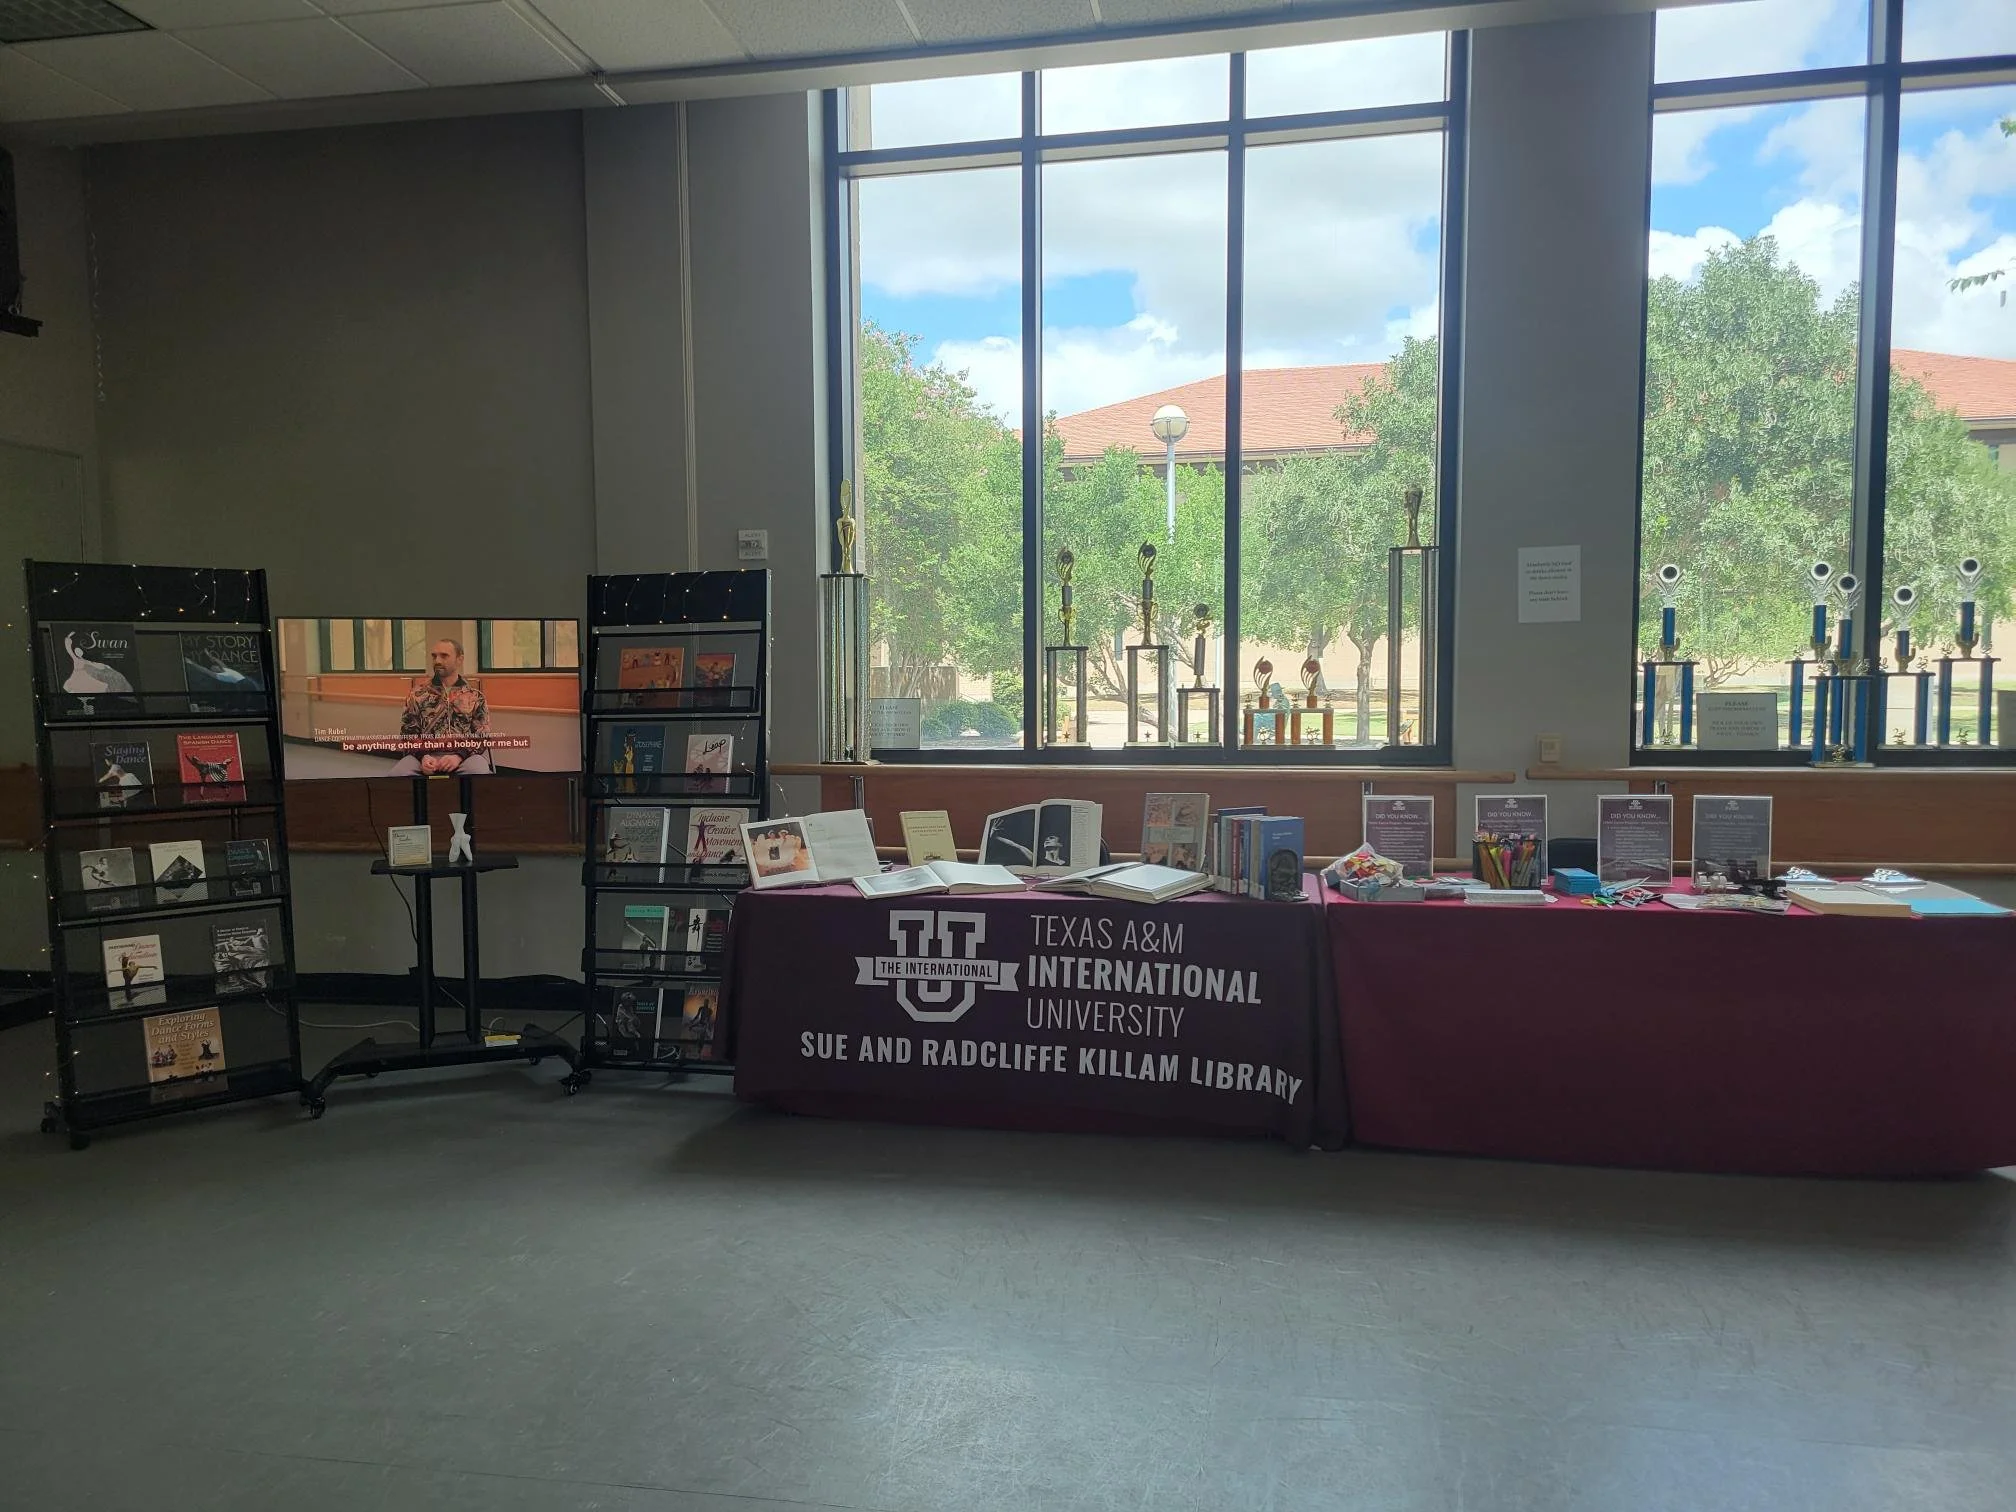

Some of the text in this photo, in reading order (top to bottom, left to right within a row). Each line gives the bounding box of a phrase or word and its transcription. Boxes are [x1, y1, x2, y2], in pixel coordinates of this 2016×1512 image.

[80, 631, 128, 650] Swan
[206, 635, 257, 649] STORY,
[209, 650, 259, 663] DANCE
[342, 742, 355, 751] be
[356, 742, 397, 752] anything
[398, 741, 423, 749] other
[424, 740, 445, 749] than
[454, 740, 481, 749] hobby
[483, 739, 496, 747] for
[513, 739, 528, 747] but
[703, 738, 727, 755] Leap
[116, 755, 147, 764] Dance
[699, 813, 730, 822] Inclusive
[707, 825, 737, 835] Creative
[1030, 914, 1185, 954] TEXAS A&M
[880, 961, 993, 978] THE INTERNATIONAL
[1027, 955, 1262, 1004] INTERNATIONAL
[159, 1012, 207, 1027] Exploring
[1026, 997, 1185, 1038] UNIVERSITY
[151, 1020, 215, 1036] Dance Forms
[159, 1030, 210, 1043] and Styles
[800, 1030, 1303, 1105] SUE AND RADCLIFFE KILLAM LIBRARY
